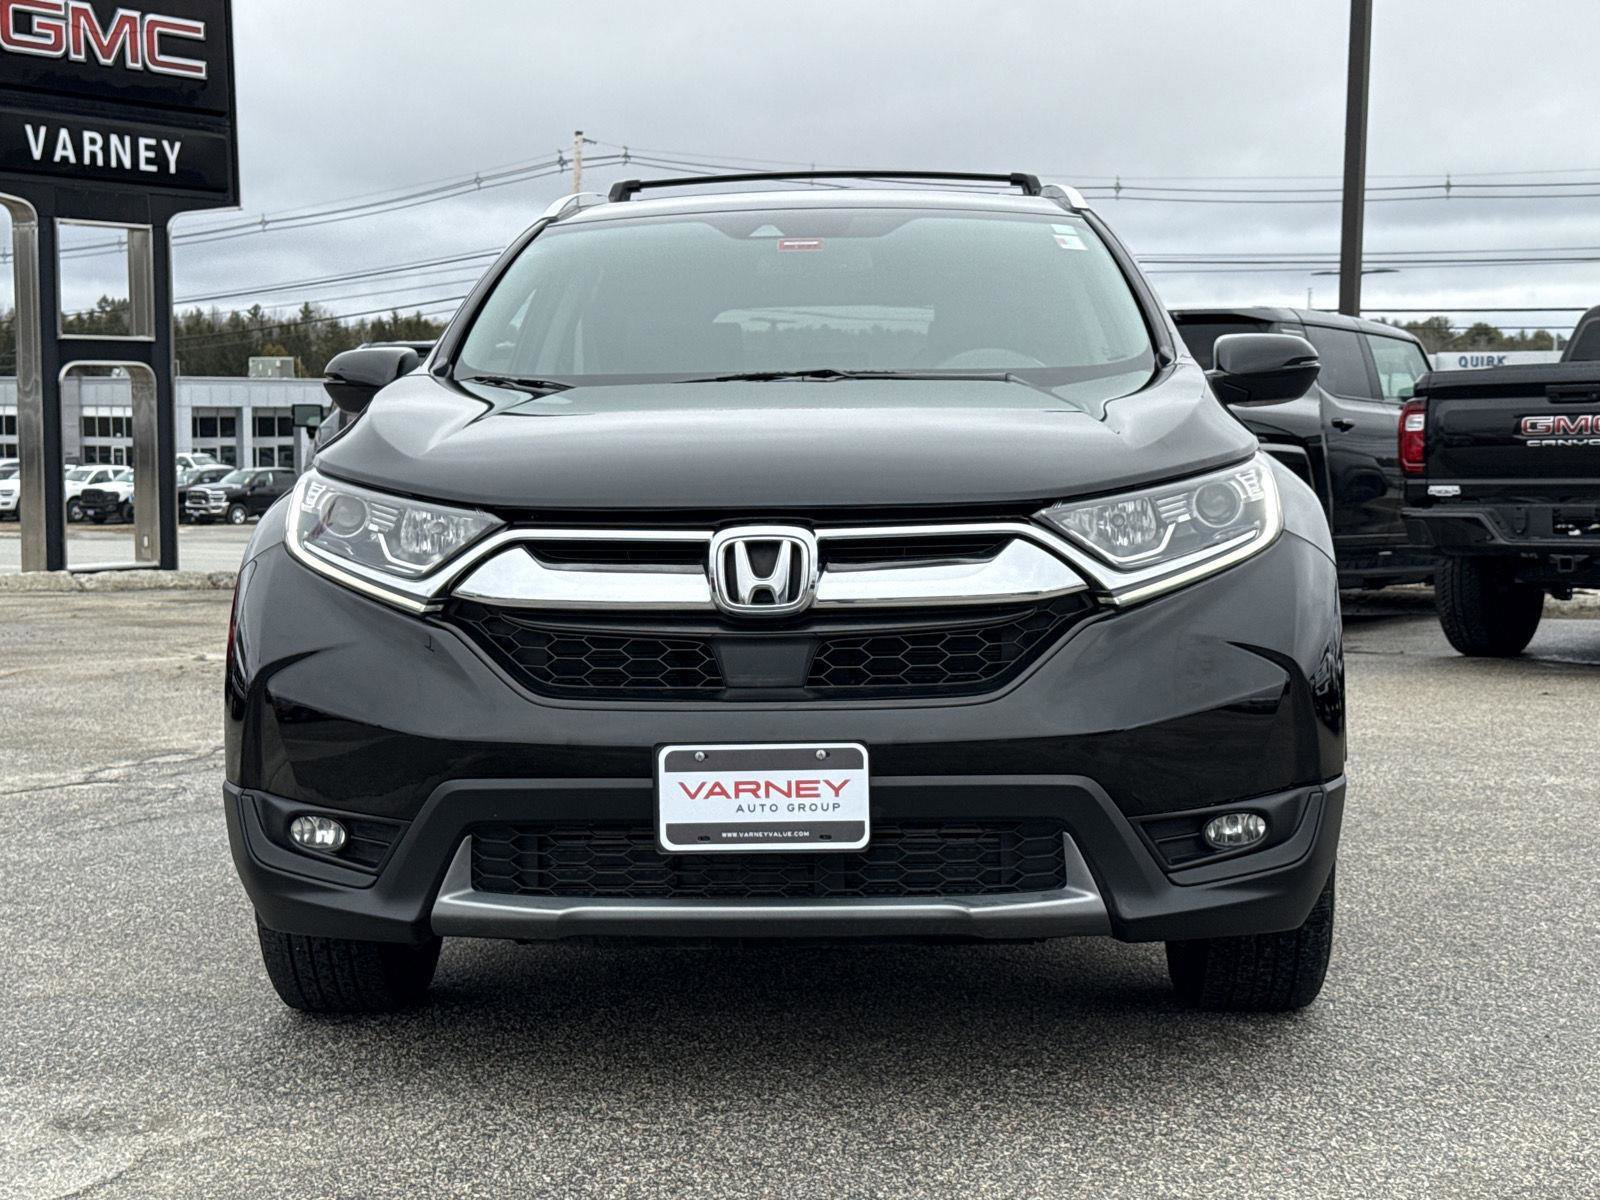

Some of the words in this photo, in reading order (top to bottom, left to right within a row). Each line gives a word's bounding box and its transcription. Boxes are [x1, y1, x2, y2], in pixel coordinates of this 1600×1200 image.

[0, 0, 207, 79] GMC
[24, 124, 181, 175] VARNEY
[1458, 355, 1506, 368] QUIRK
[1521, 415, 1600, 435] GM
[677, 779, 850, 800] VARNEY
[736, 803, 778, 813] AUTO
[787, 802, 841, 812] GROUP
